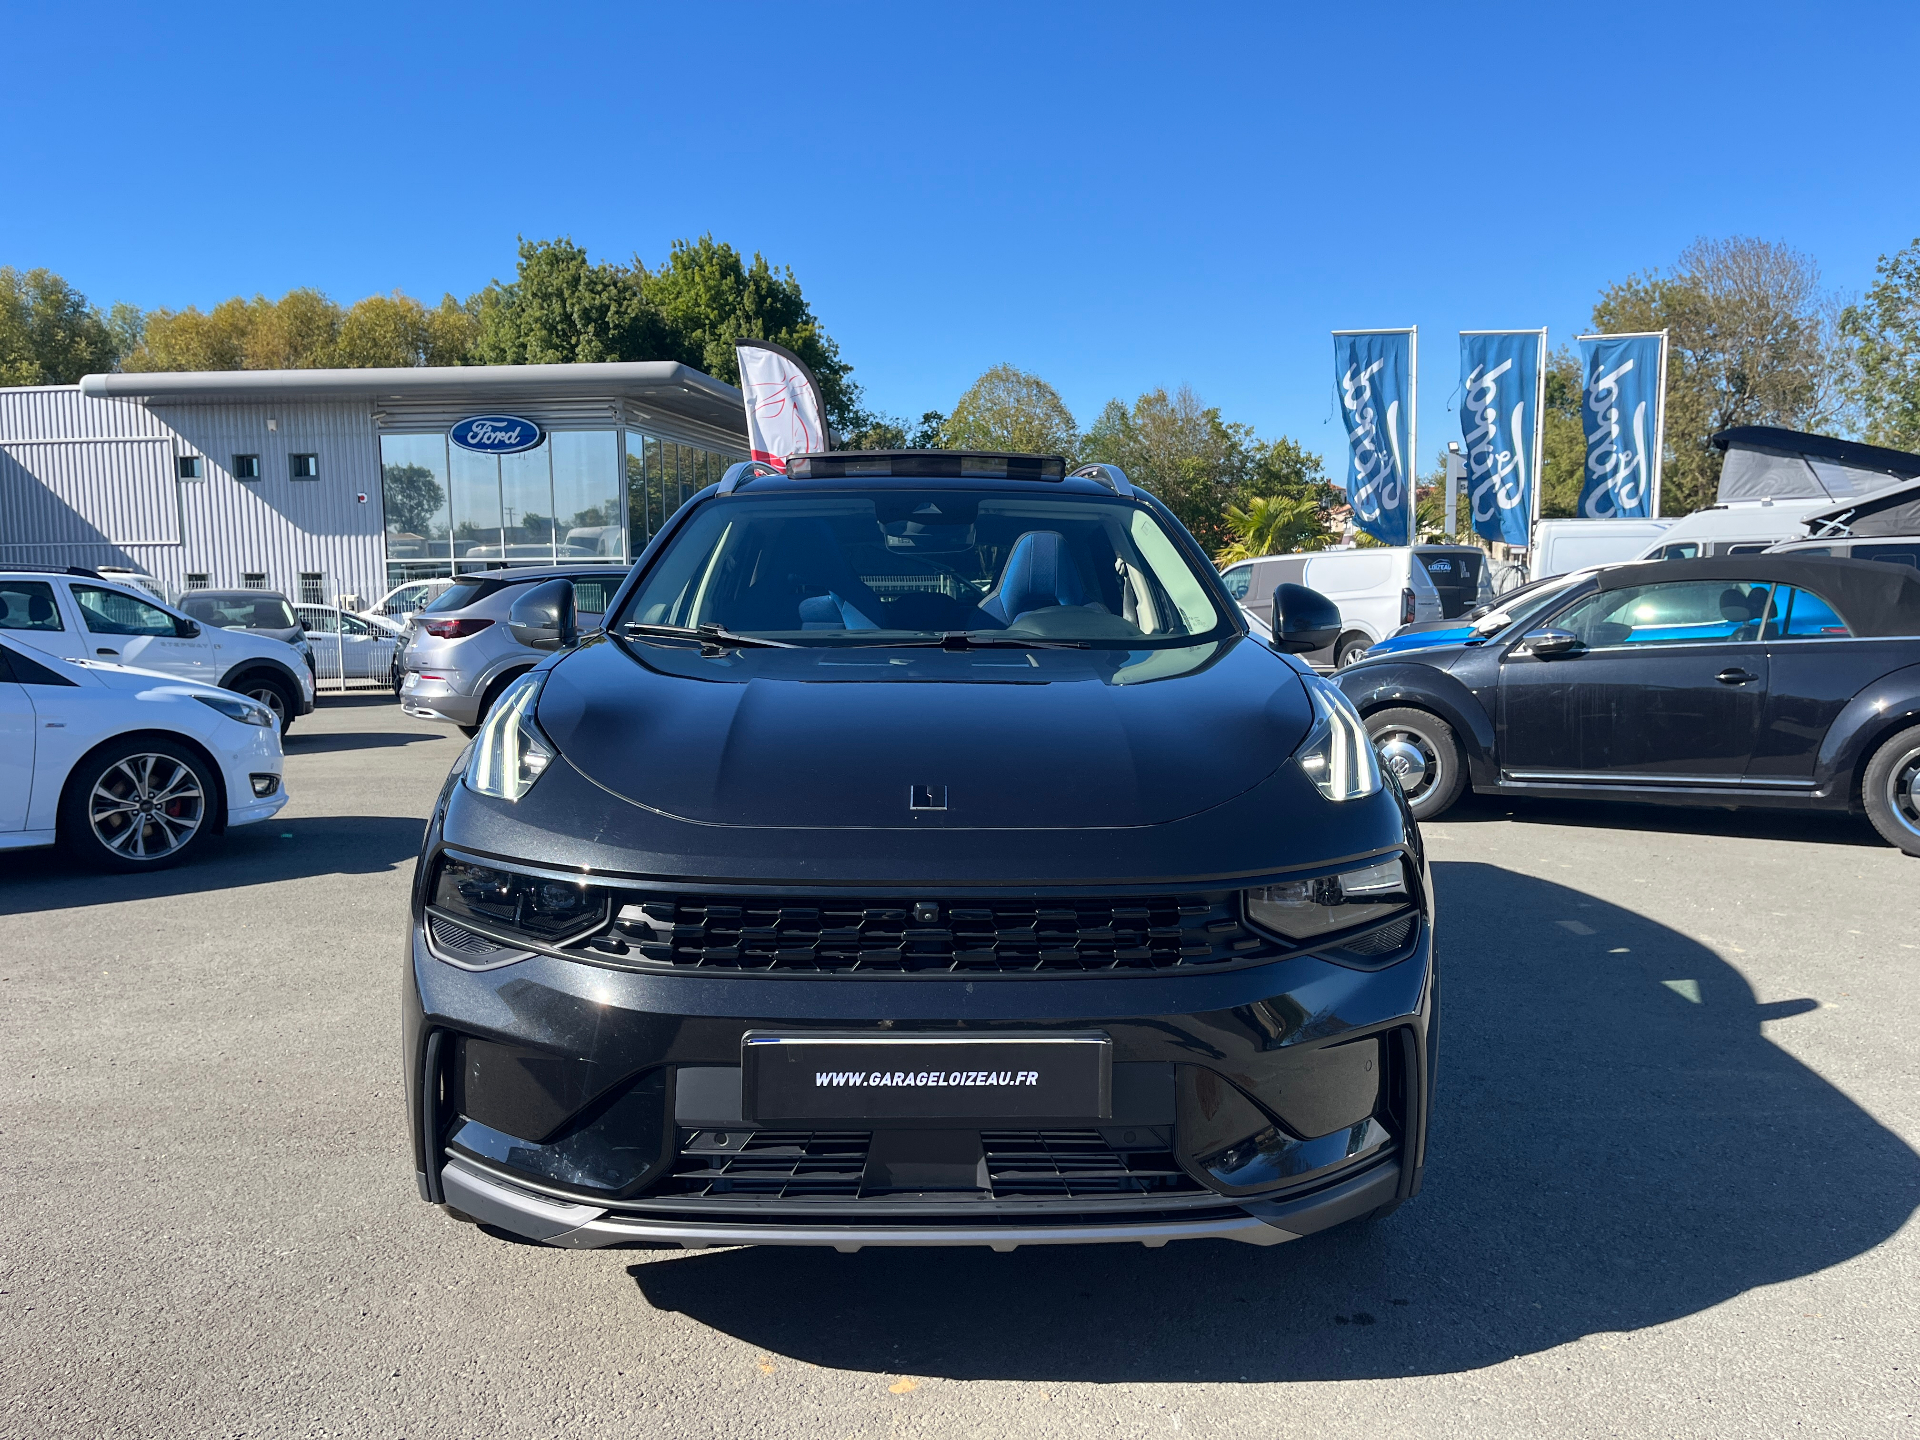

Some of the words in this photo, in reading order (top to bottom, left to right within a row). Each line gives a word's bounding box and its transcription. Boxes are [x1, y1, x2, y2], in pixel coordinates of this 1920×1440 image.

[467, 420, 521, 444] Ford
[160, 641, 208, 649] STEPWAY
[815, 1071, 1039, 1087] WWW.GARAGELOIZEAU.FR
